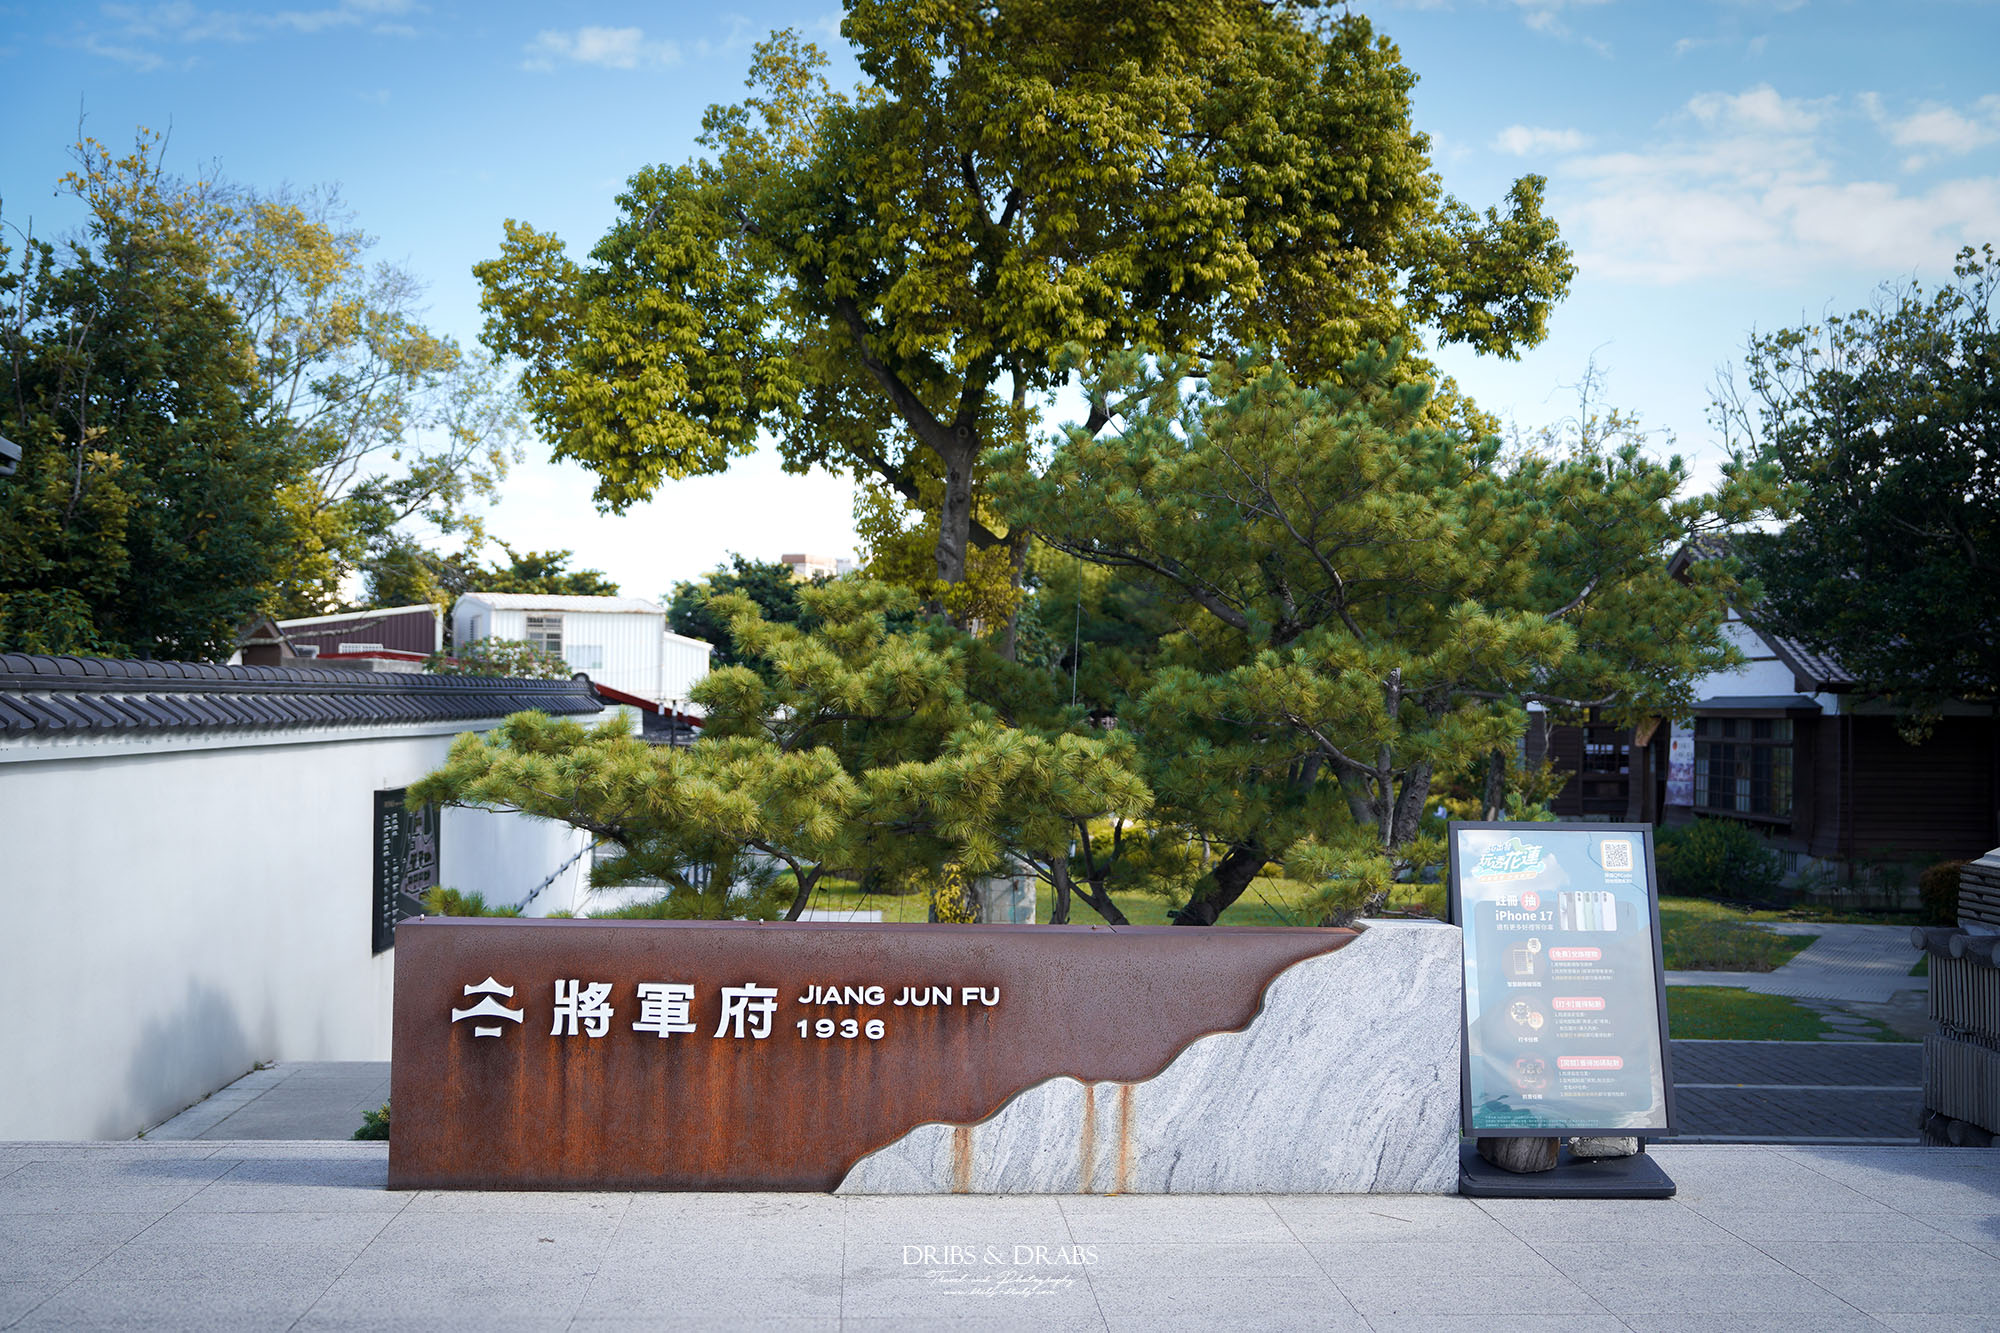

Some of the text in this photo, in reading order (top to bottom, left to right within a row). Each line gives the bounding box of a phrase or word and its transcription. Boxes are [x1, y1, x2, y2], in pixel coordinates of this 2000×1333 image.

[1480, 846, 1543, 870] 玩透花蓮
[1524, 894, 1537, 907] 抽
[1495, 909, 1554, 921] iPhone 17
[798, 985, 1000, 1007] JIANG JUN FU
[550, 979, 778, 1038] 將軍府
[796, 1018, 886, 1040] 1936
